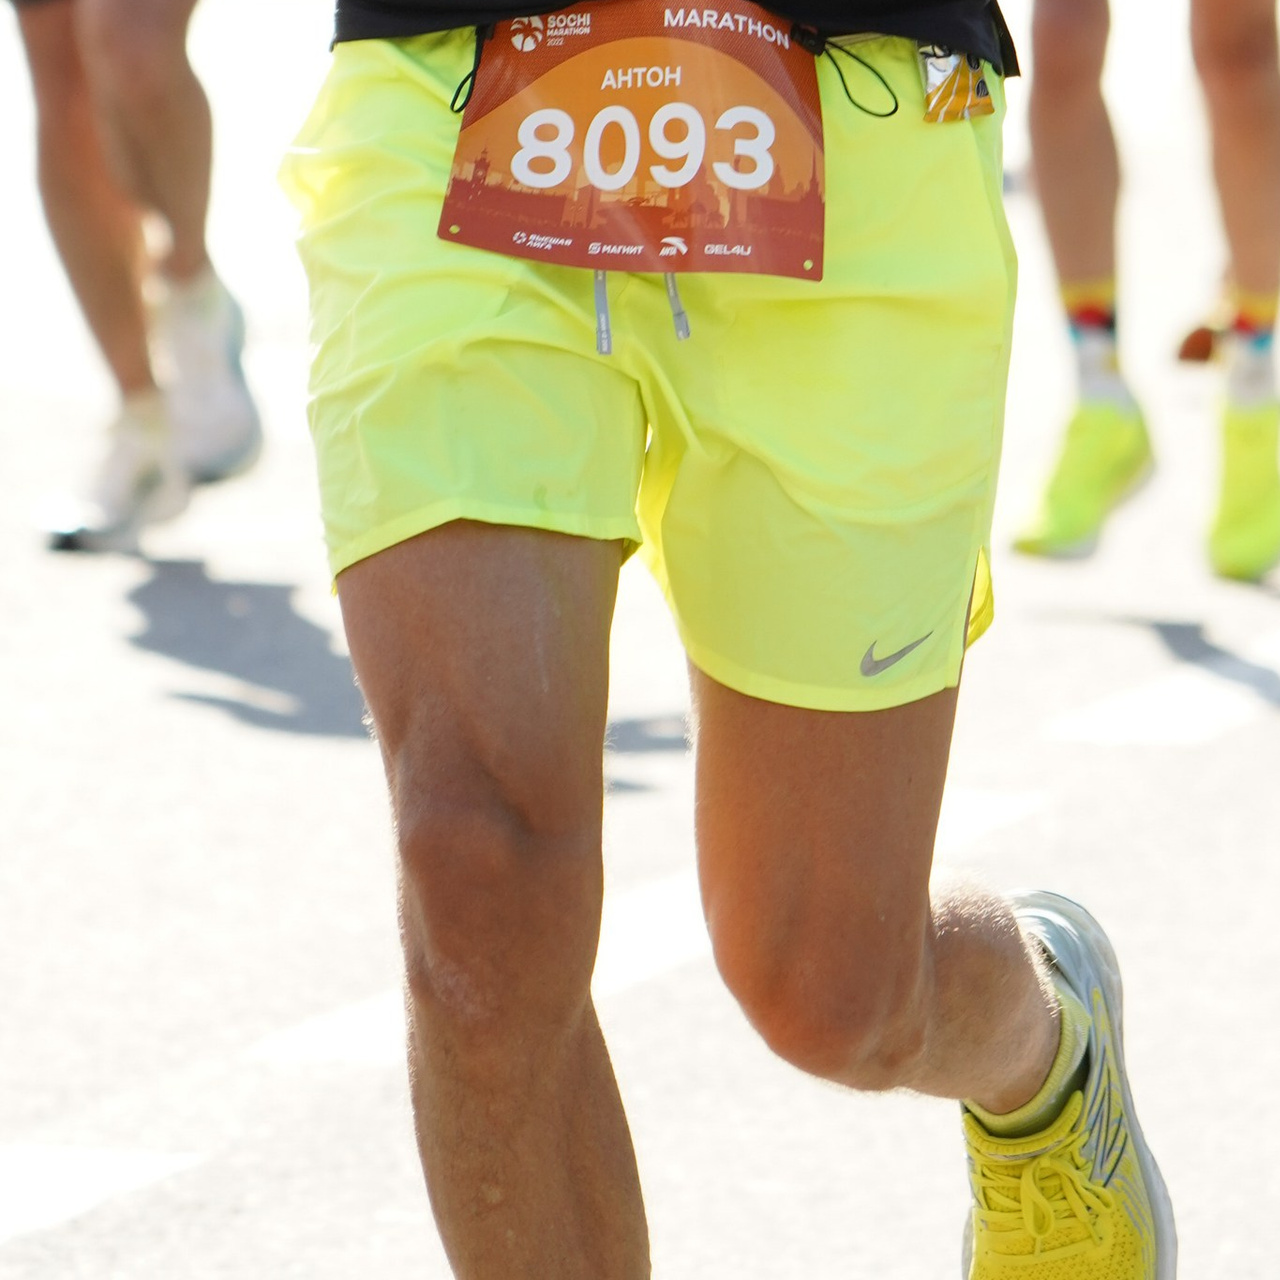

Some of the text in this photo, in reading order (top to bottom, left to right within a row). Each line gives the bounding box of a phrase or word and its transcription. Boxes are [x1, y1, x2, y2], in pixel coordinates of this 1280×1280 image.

[547, 13, 592, 28] SOCHI
[664, 8, 790, 50] MARATHON
[547, 26, 591, 37] MARATHON
[600, 66, 682, 91] АНТОН
[510, 102, 776, 191] 8093
[601, 244, 644, 255] МАГНИТ
